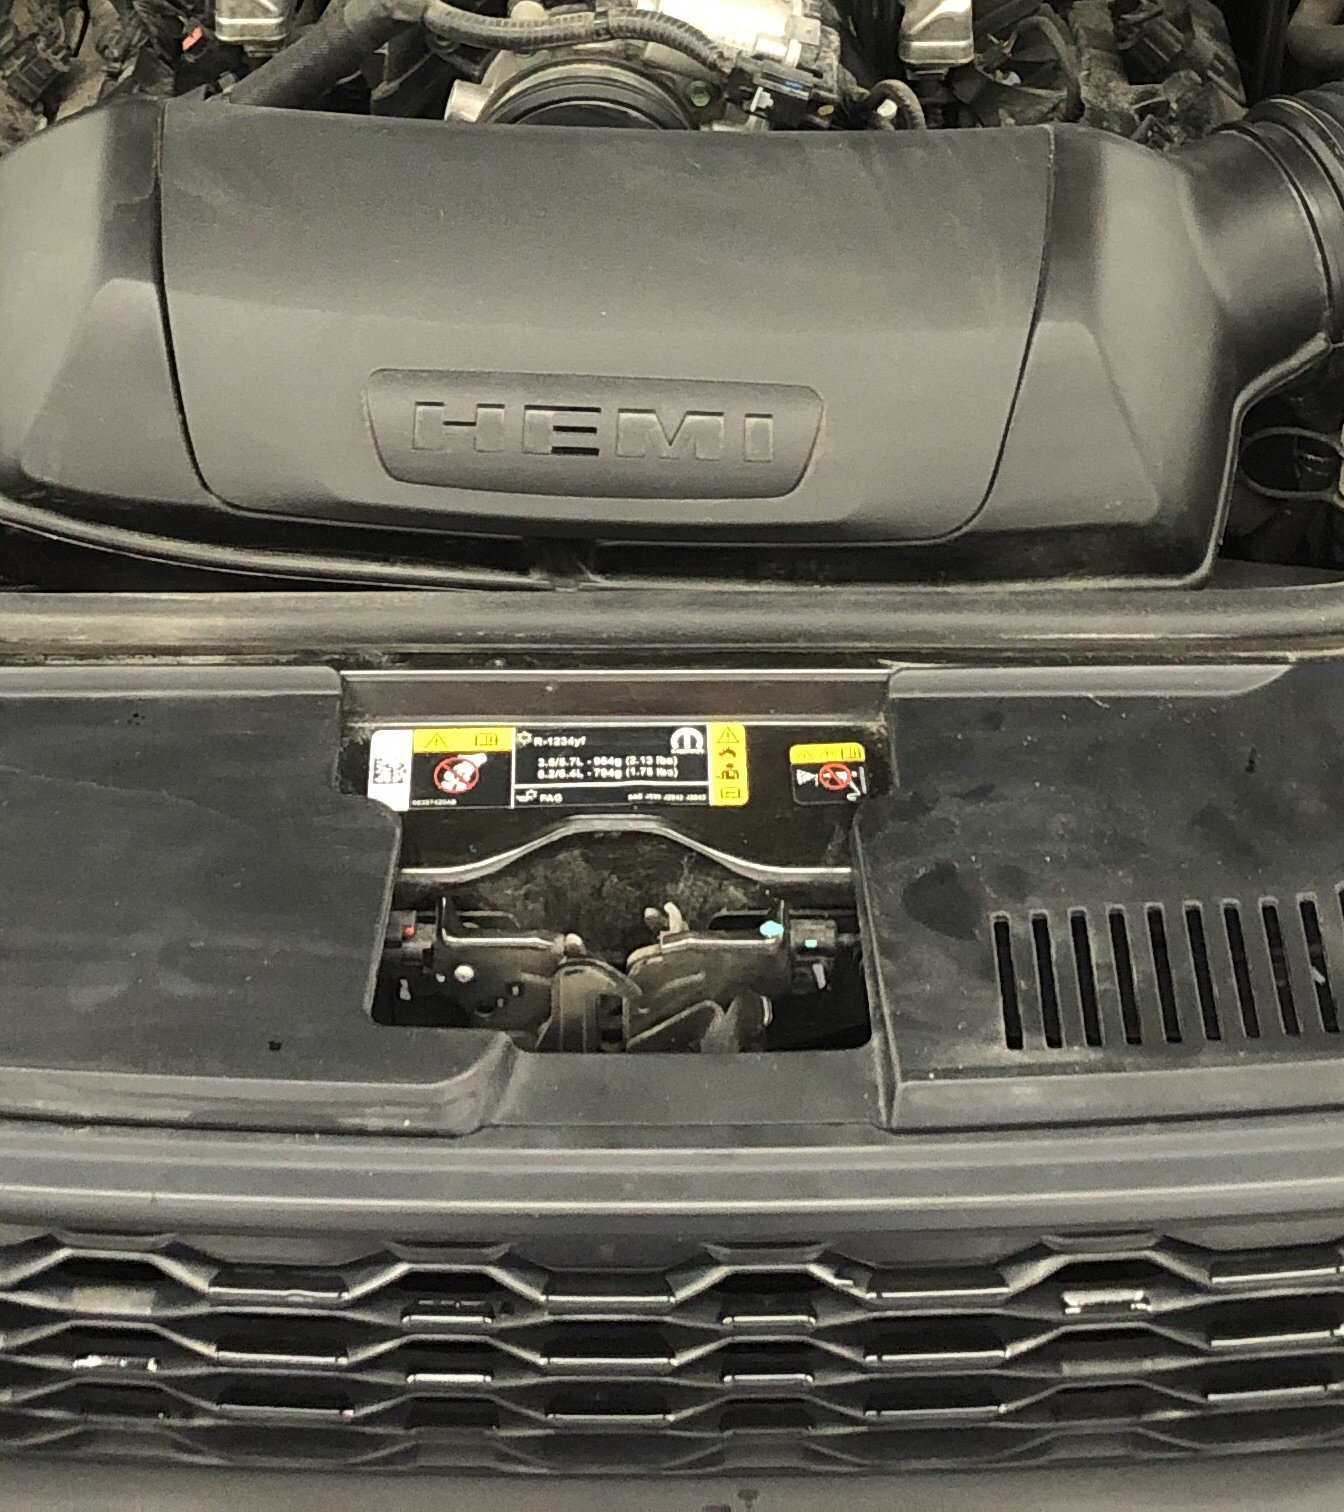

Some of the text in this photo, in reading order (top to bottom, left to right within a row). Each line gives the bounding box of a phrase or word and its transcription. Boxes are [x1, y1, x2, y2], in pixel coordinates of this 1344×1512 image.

[411, 400, 774, 463] HEMI
[533, 736, 587, 748] R-1234yf
[539, 793, 563, 803] PAG
